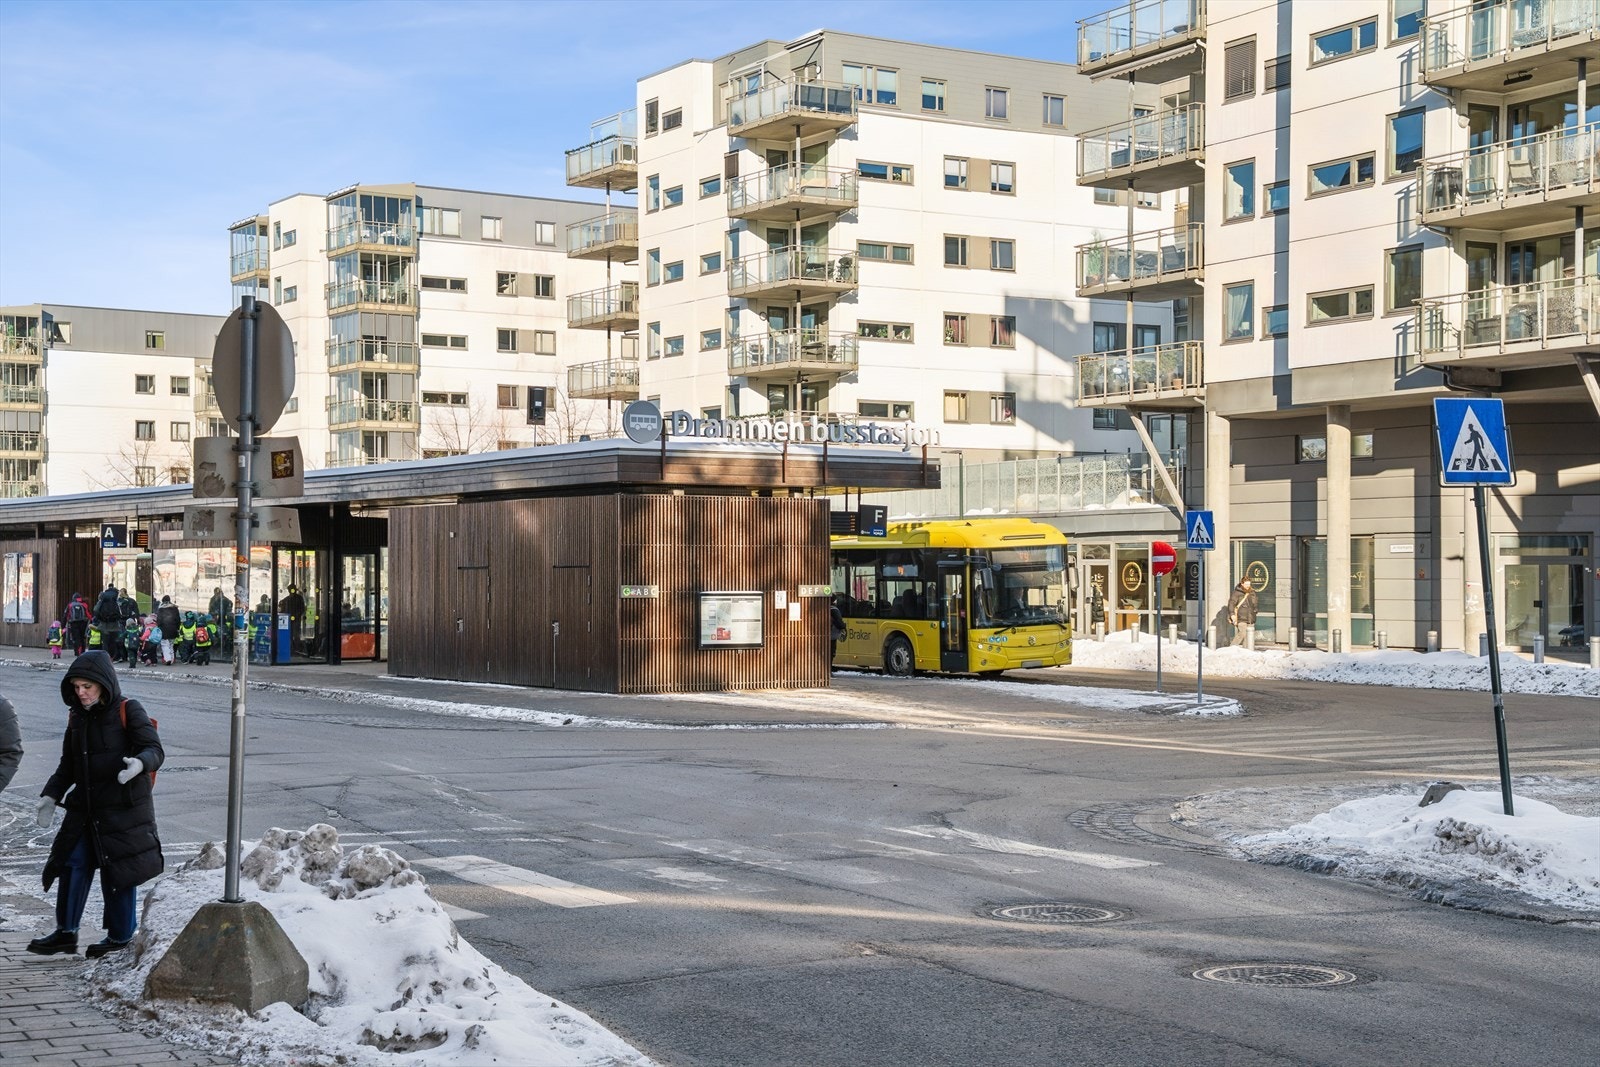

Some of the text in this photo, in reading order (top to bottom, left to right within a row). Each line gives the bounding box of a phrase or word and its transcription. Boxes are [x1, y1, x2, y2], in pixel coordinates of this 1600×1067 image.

[671, 409, 941, 453] Drammen busstasjon
[874, 510, 884, 523] F
[104, 527, 114, 538] A
[1419, 544, 1425, 553] 2
[849, 628, 872, 640] Brakar
